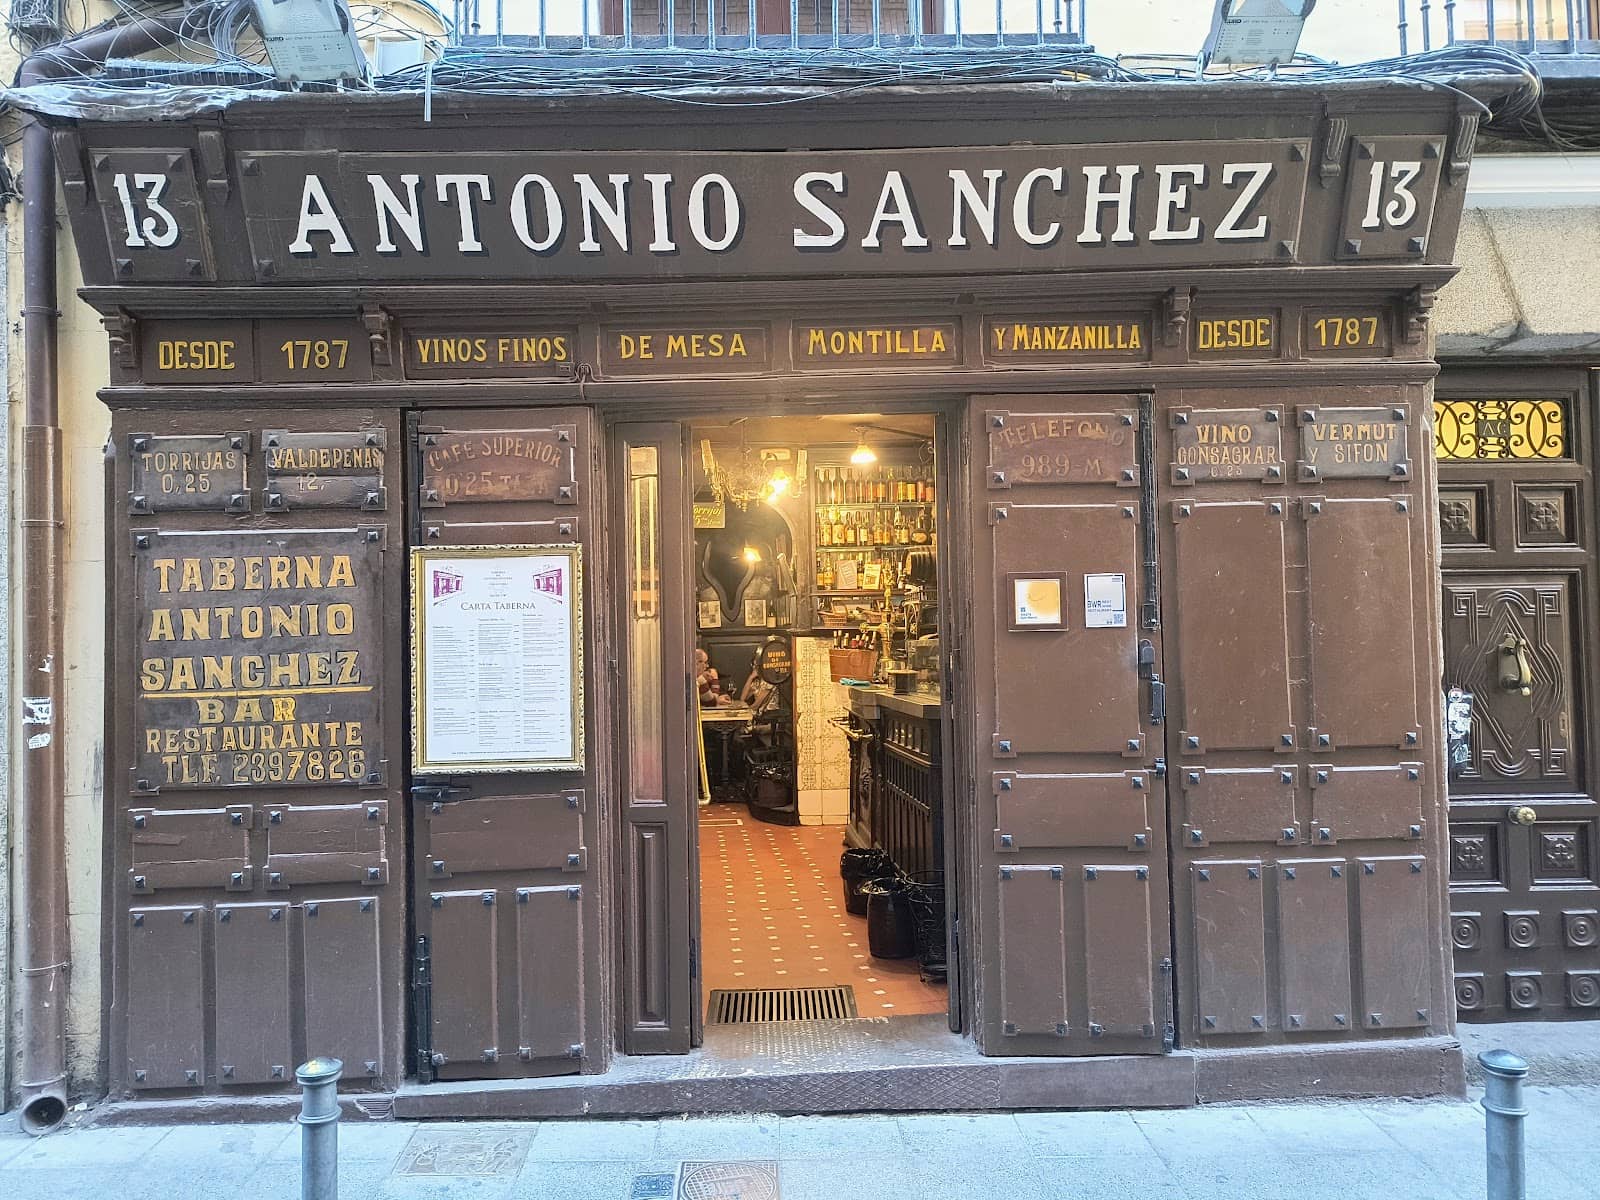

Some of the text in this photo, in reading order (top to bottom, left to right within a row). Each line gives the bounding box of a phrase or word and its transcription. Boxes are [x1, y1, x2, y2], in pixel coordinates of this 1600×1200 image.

[112, 173, 180, 249] 13
[288, 161, 1274, 254] ANTONIO SANCHEZ
[1360, 160, 1422, 231] 13
[620, 333, 748, 360] DE MESA
[808, 328, 948, 356] MONTILLA
[994, 323, 1142, 352] Y MANZANILLA
[1198, 316, 1379, 350] DESDE 1787
[158, 339, 349, 371] DESDE 1787
[417, 336, 567, 364] VINOS FINOS
[1196, 423, 1253, 444] VINO
[1311, 423, 1398, 442] VERMUT
[141, 451, 237, 473] TORRIJAS
[481, 436, 562, 469] SUPERIOR
[1334, 443, 1389, 463] SIFON
[161, 473, 212, 494] 0,25
[153, 555, 357, 593] TABERNA
[148, 603, 355, 642] ANTONIO
[140, 650, 361, 691] SANCHEZ
[197, 697, 297, 724] BAR
[145, 721, 363, 754] RESTAURANTE
[233, 748, 367, 783] 2397826
